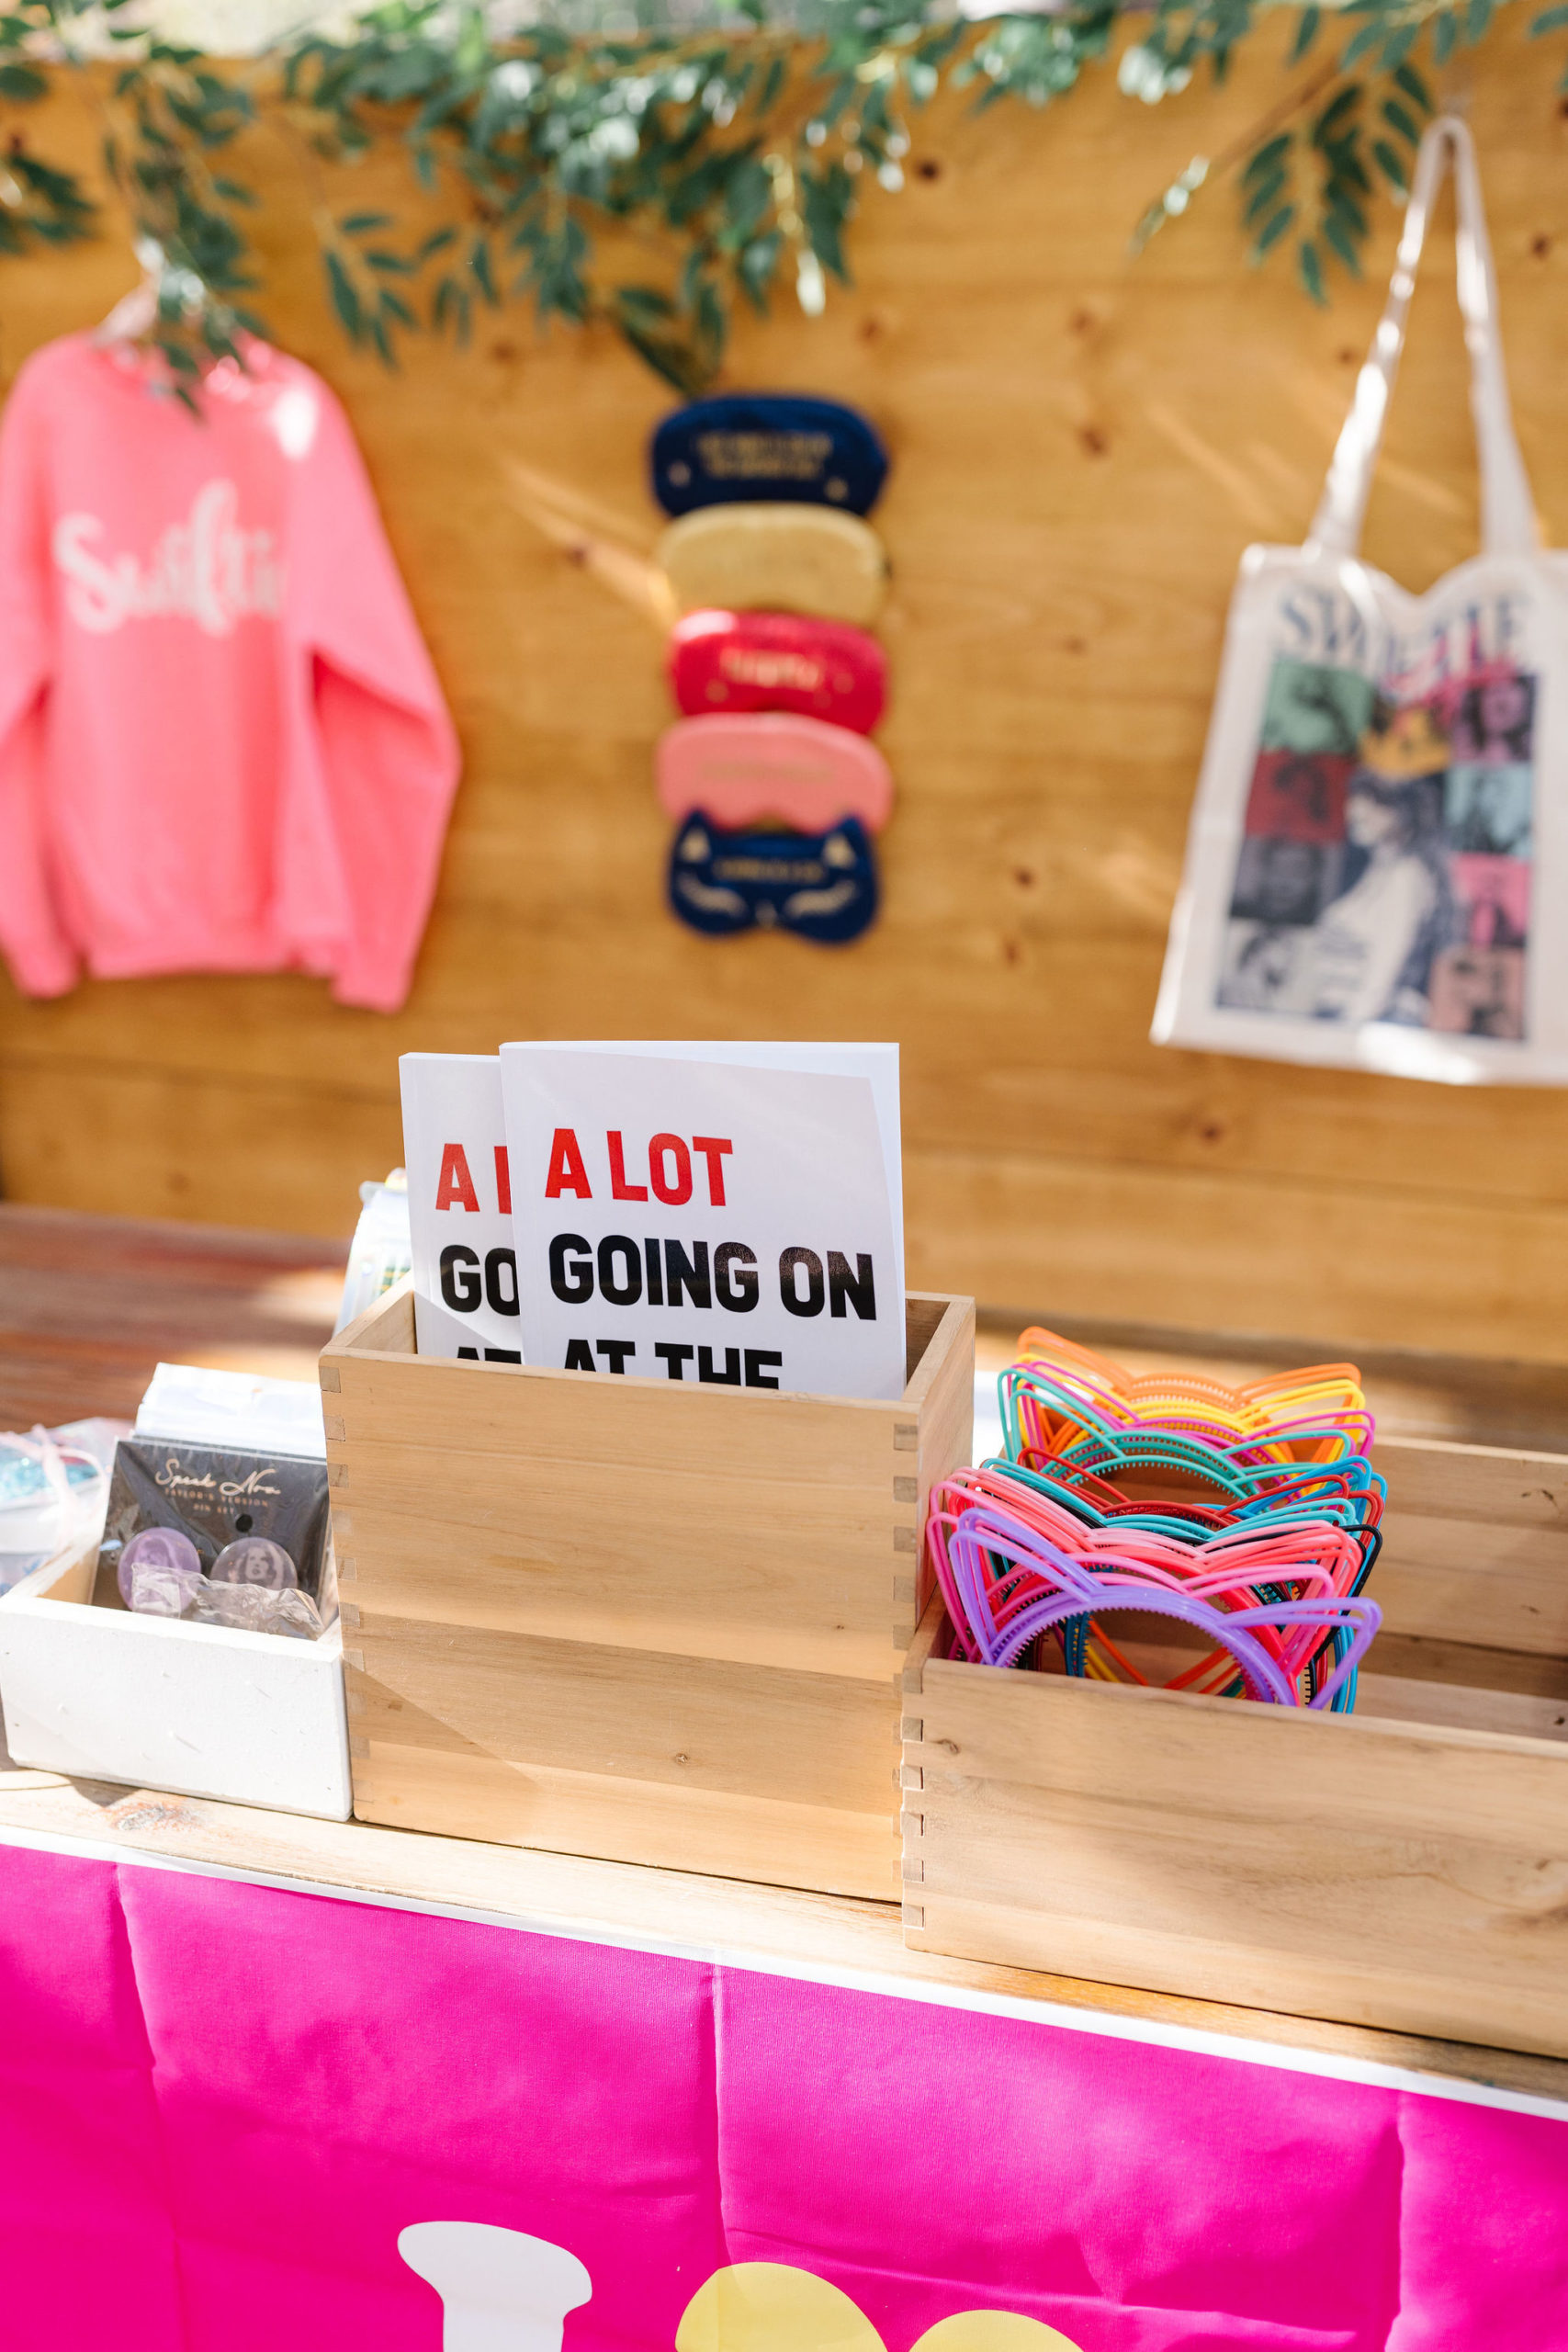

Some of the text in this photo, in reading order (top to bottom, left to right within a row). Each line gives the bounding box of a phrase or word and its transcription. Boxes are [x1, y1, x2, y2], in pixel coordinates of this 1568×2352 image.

[435, 1143, 480, 1213] A
[545, 1128, 592, 1199] A
[606, 1130, 733, 1206] LOT
[549, 1233, 877, 1321] GOING ON
[655, 1342, 783, 1389] THE
[220, 1496, 268, 1507] VERSION
